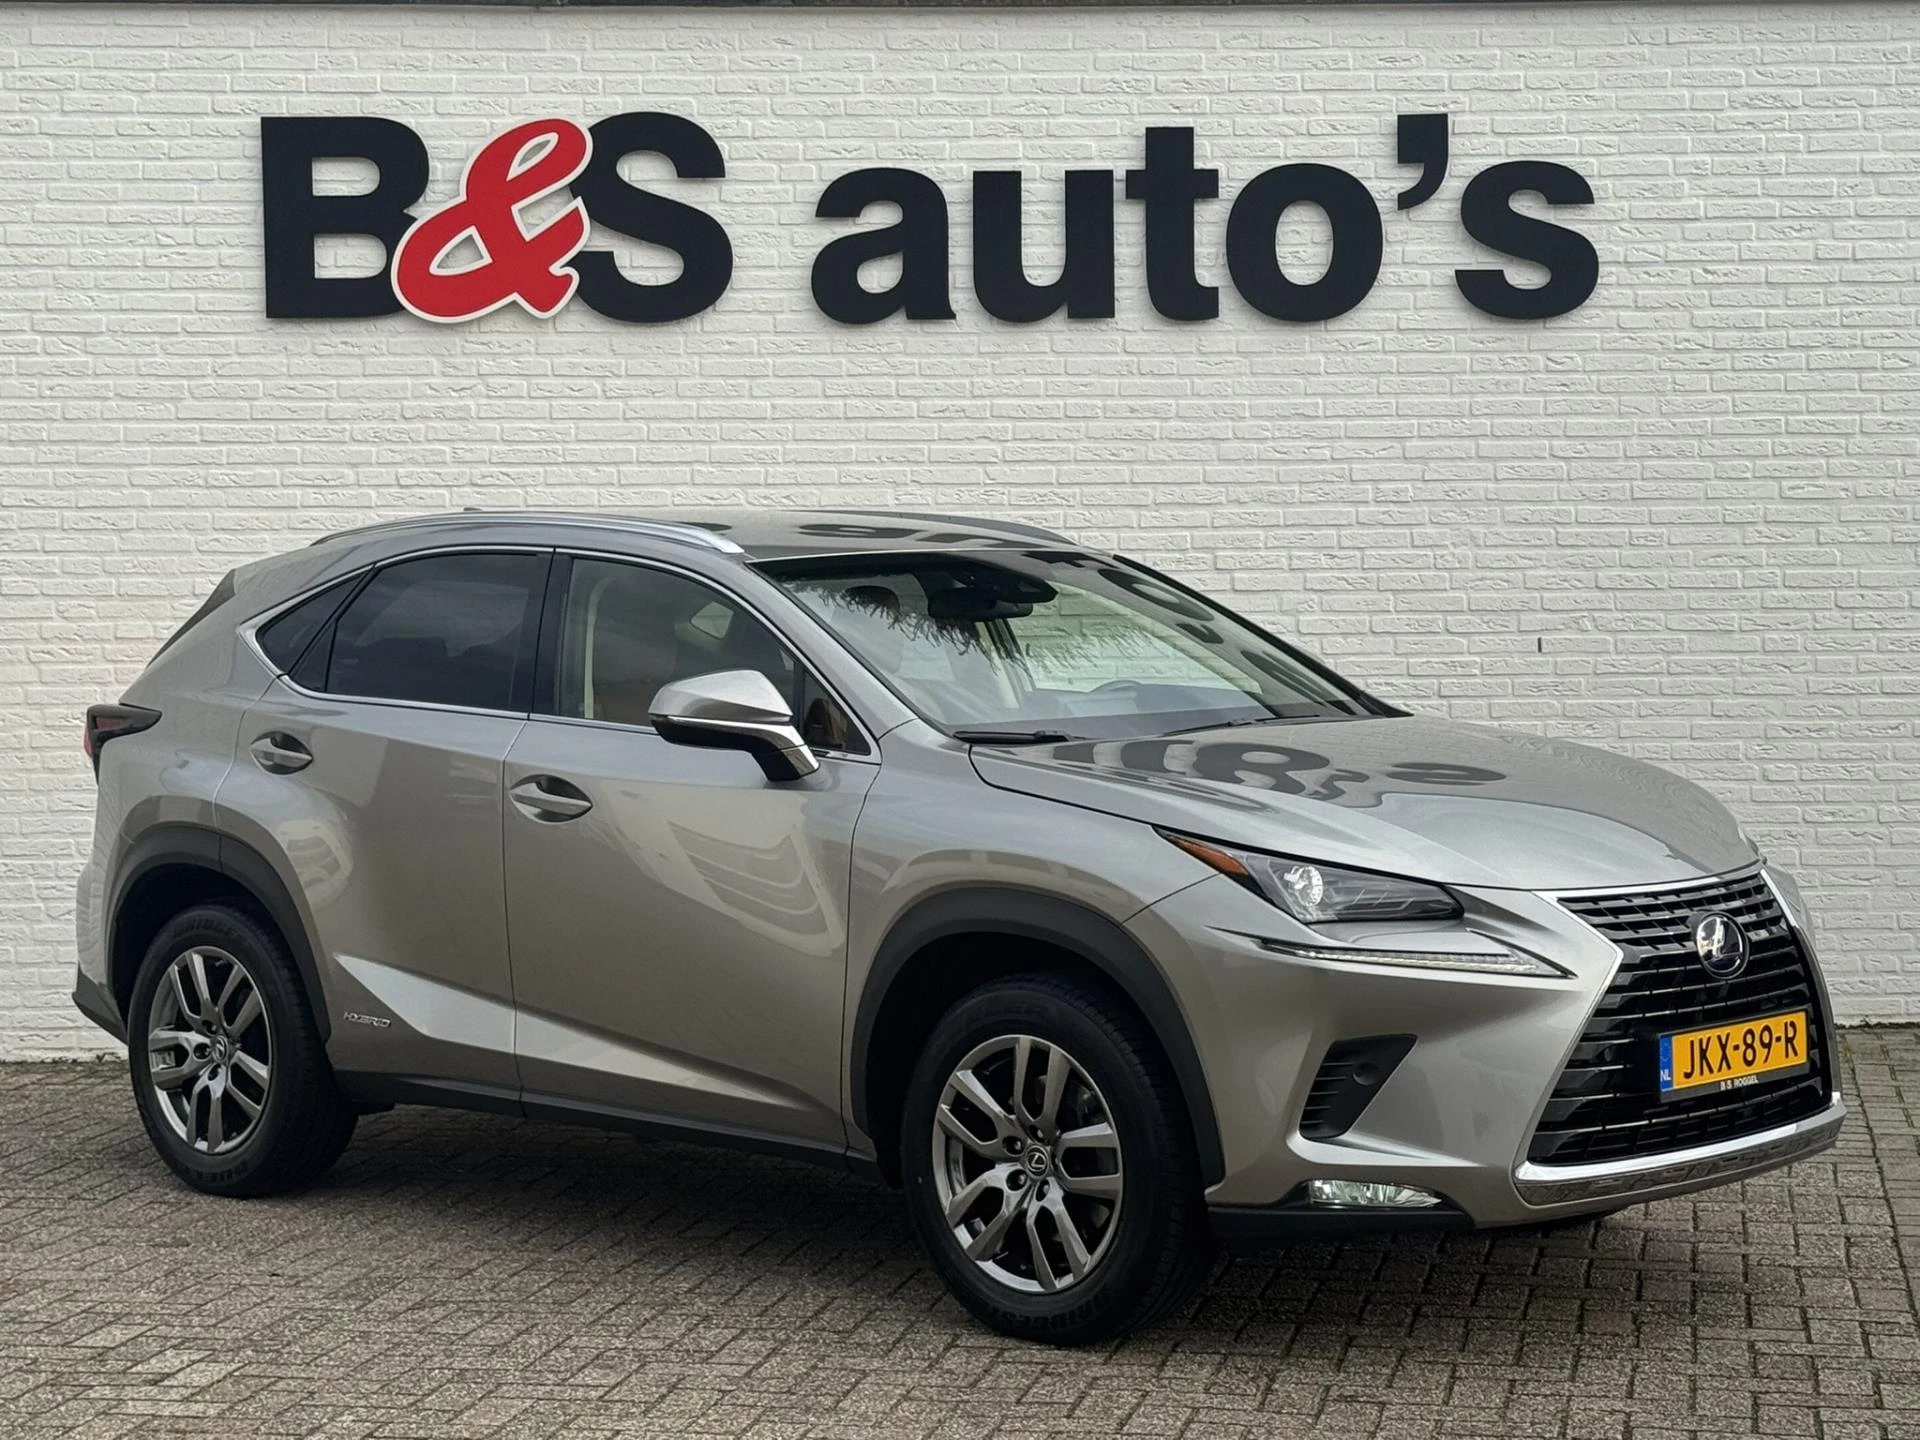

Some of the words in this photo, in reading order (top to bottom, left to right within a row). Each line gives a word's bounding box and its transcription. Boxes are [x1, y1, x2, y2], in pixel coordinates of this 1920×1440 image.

[261, 111, 733, 323] B&S
[811, 113, 1599, 324] auto's
[1660, 1069, 1672, 1083] NL
[1683, 1020, 1798, 1079] JKX-89-R
